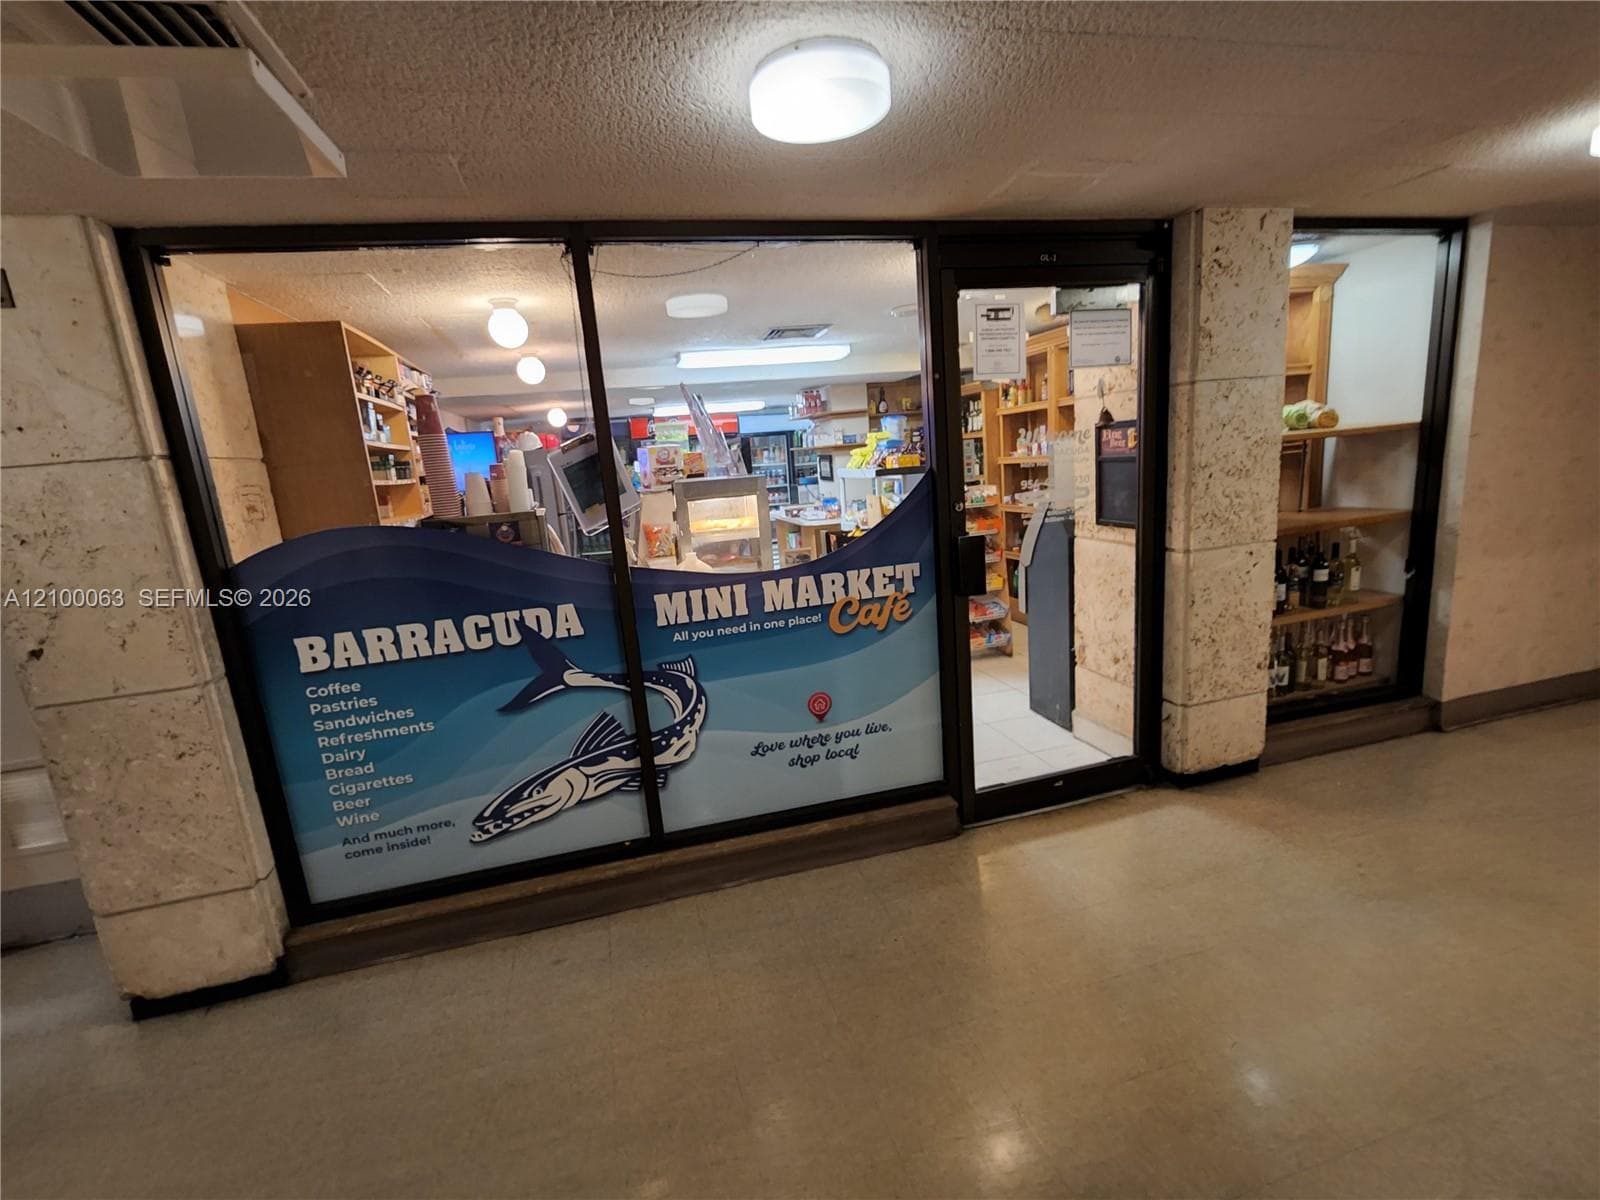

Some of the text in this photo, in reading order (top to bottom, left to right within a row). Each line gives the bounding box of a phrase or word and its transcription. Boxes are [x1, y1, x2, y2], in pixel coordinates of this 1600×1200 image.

[653, 562, 920, 627] MINI MARKET
[828, 591, 913, 634] Café
[293, 603, 585, 673] BARRACUDA
[672, 613, 822, 643] All you need in one place!
[305, 682, 361, 698] Coffee
[309, 696, 378, 715] Pastries
[313, 707, 415, 731] Sandwiches
[317, 721, 435, 748] Refreshments
[750, 741, 786, 757] Love
[789, 734, 832, 749] where
[835, 728, 862, 744] you
[321, 748, 367, 765] Dairy
[788, 743, 860, 768] shop local
[325, 761, 375, 781] Bread
[328, 773, 415, 796] Cigarettes
[332, 797, 372, 811] Beer
[336, 811, 380, 827] Wine
[342, 819, 456, 847] And much more,
[344, 835, 431, 860] come inside!
